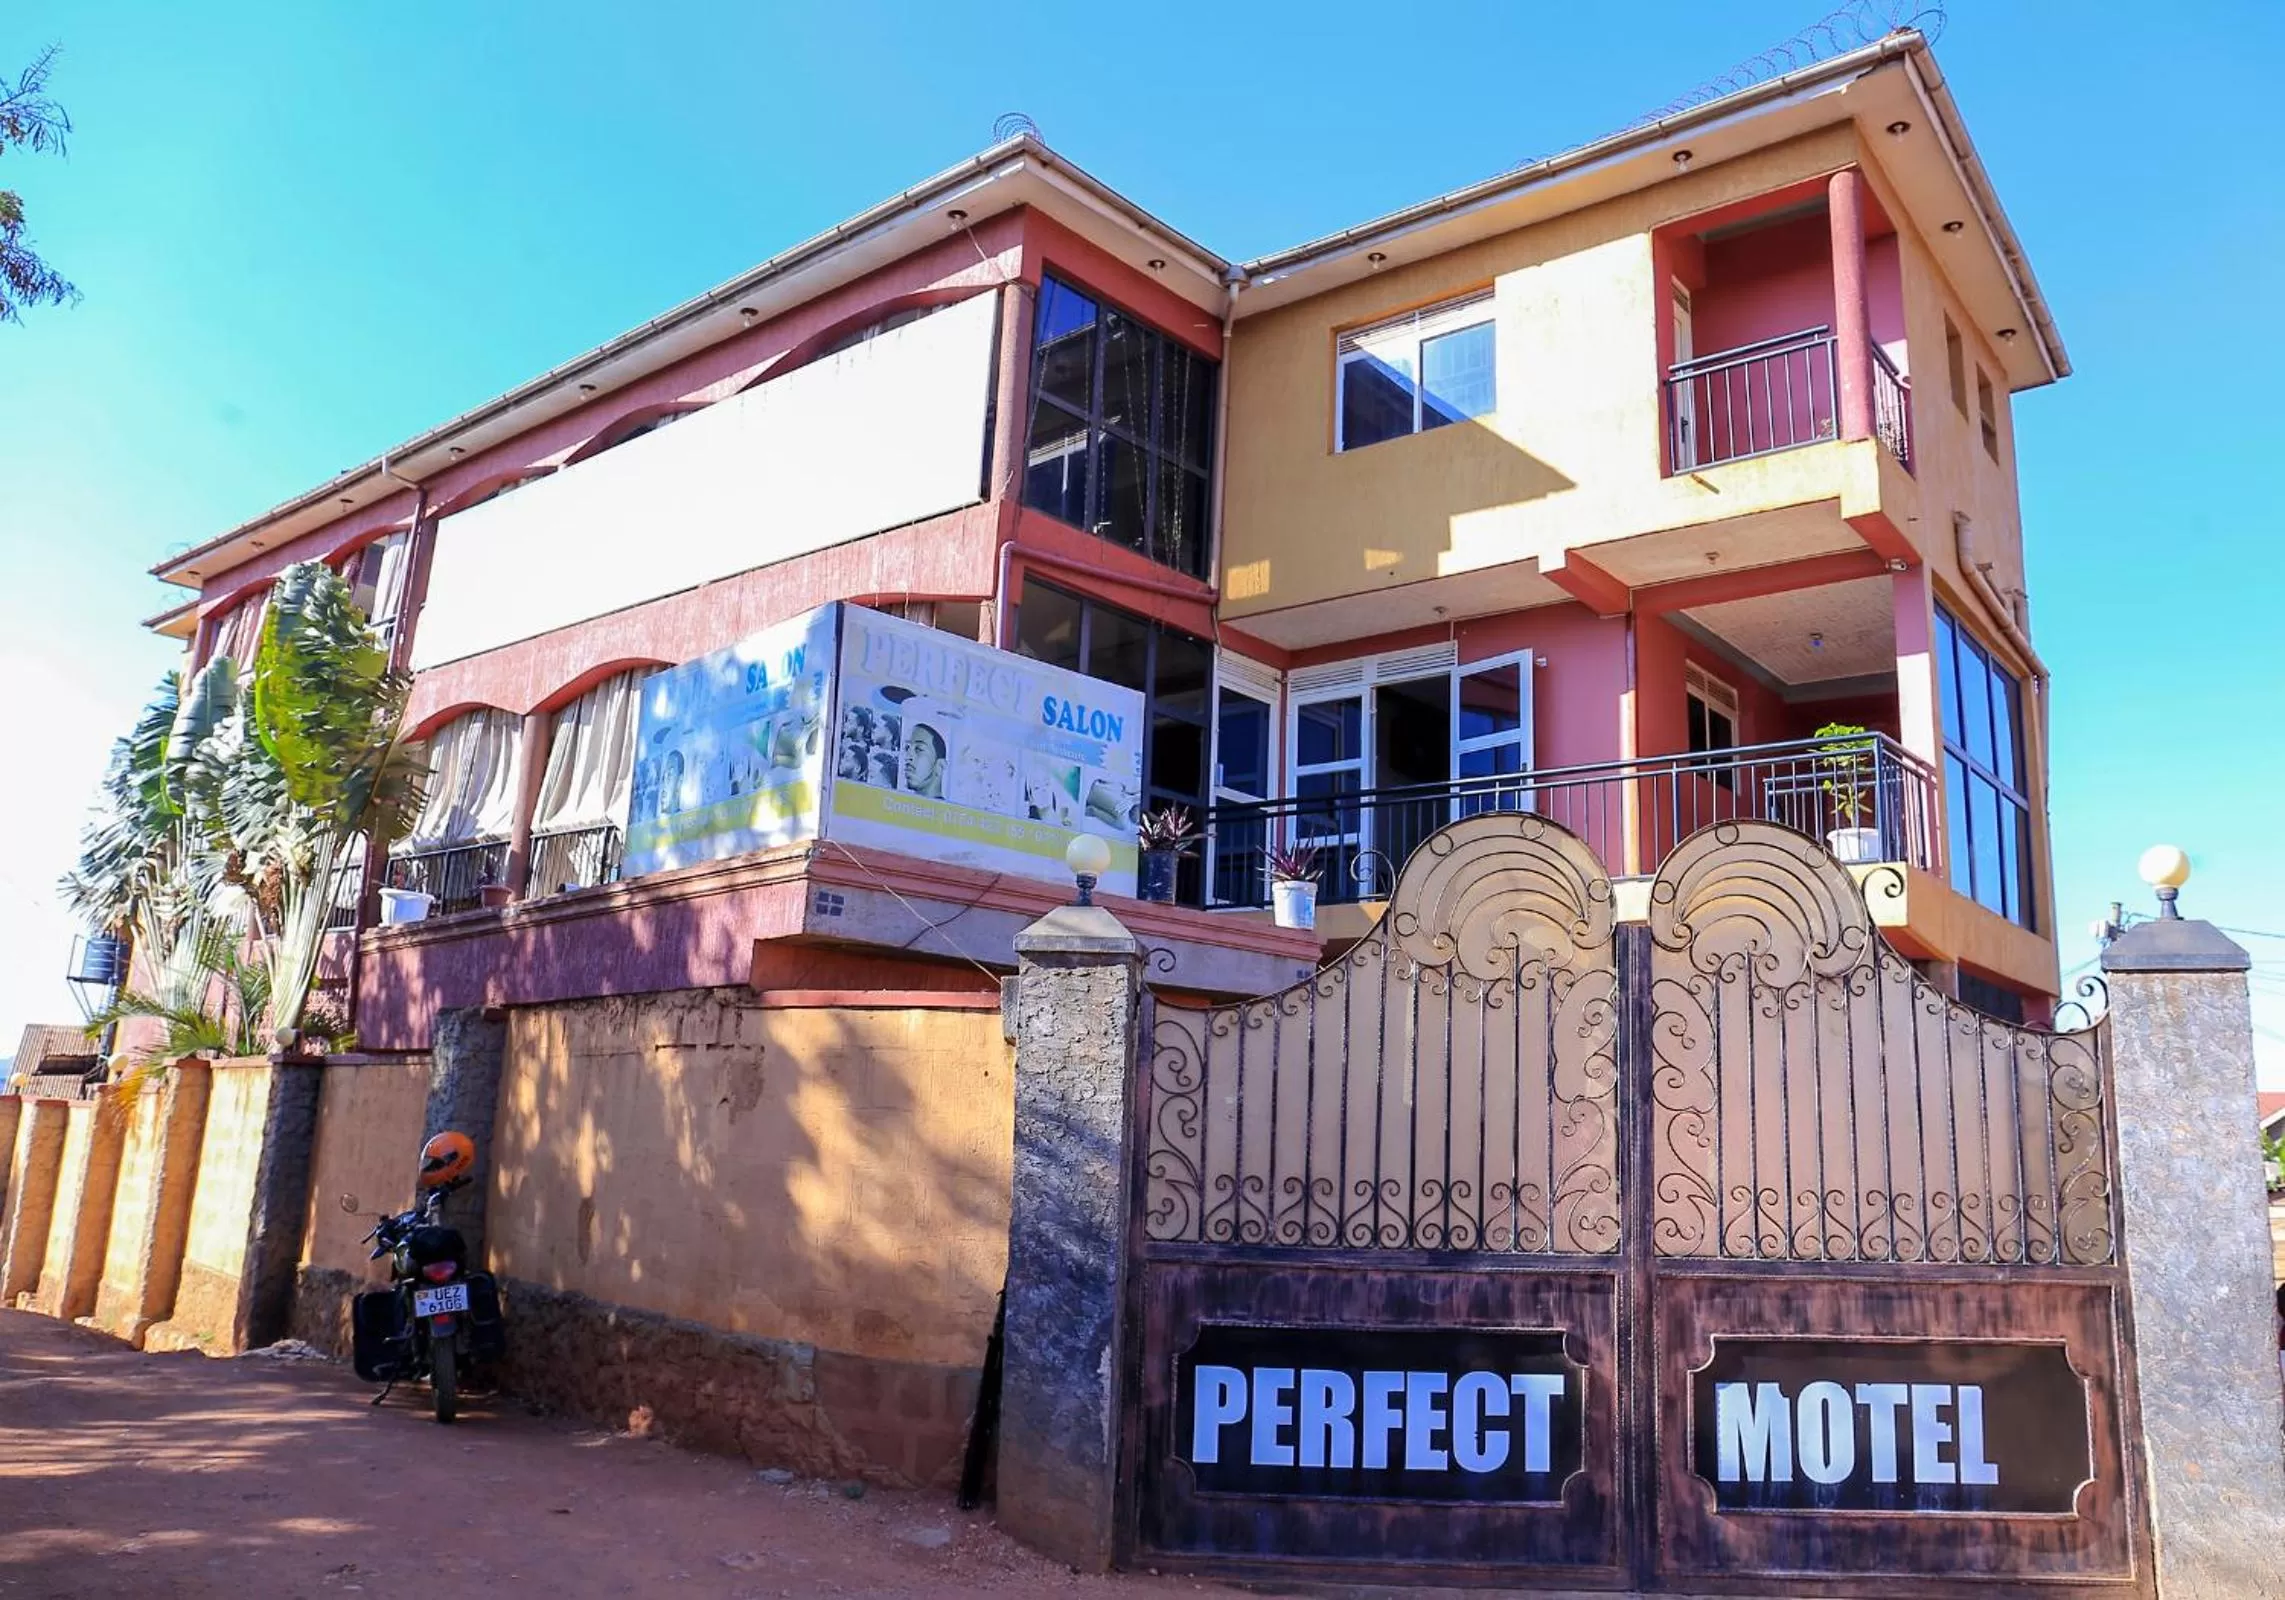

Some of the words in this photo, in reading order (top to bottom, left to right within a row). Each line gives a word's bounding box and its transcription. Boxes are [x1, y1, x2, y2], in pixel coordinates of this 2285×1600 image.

[746, 643, 807, 695] SAON
[862, 626, 1036, 714] PERFECT
[1042, 695, 1124, 742] SALON
[434, 1286, 462, 1301] UEZ
[1193, 1364, 1564, 1473] PERFECT
[1715, 1381, 1999, 1485] MOTEL
